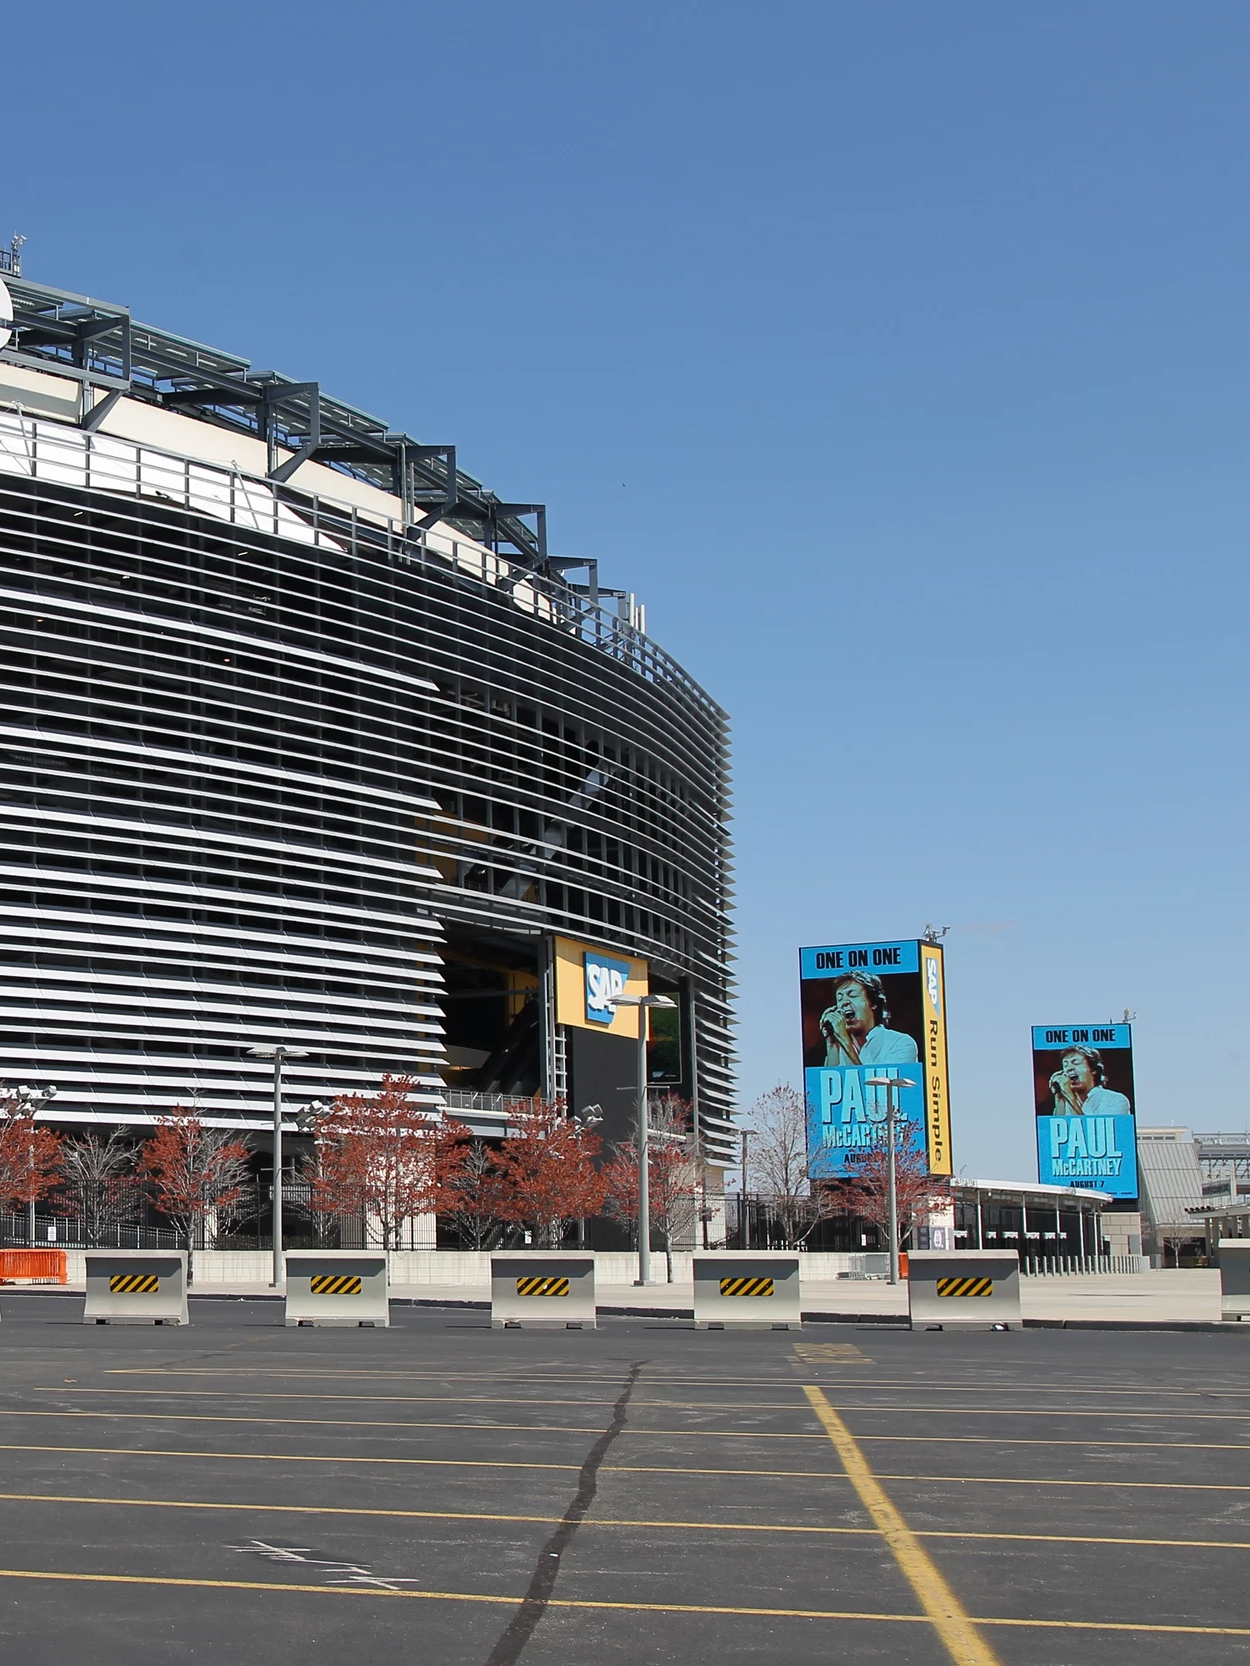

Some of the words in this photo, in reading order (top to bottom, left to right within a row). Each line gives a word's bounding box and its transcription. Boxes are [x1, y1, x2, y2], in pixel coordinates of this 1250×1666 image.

[816, 951, 844, 969] ONE
[848, 949, 868, 967] ON
[873, 947, 901, 966] ONE
[587, 964, 623, 1013] SAP
[927, 959, 938, 1004] SAP
[929, 1019, 938, 1067] Run
[1045, 1030, 1069, 1043] ONE
[1072, 1029, 1089, 1042] ON
[1093, 1028, 1116, 1042] ONE
[820, 1067, 908, 1124] PAUL
[931, 1076, 943, 1162] Simple
[1050, 1117, 1123, 1159] PAUL
[1052, 1158, 1123, 1177] McCARTNEY
[1070, 1180, 1098, 1188] AUGUST
[1098, 1180, 1105, 1188] 7
